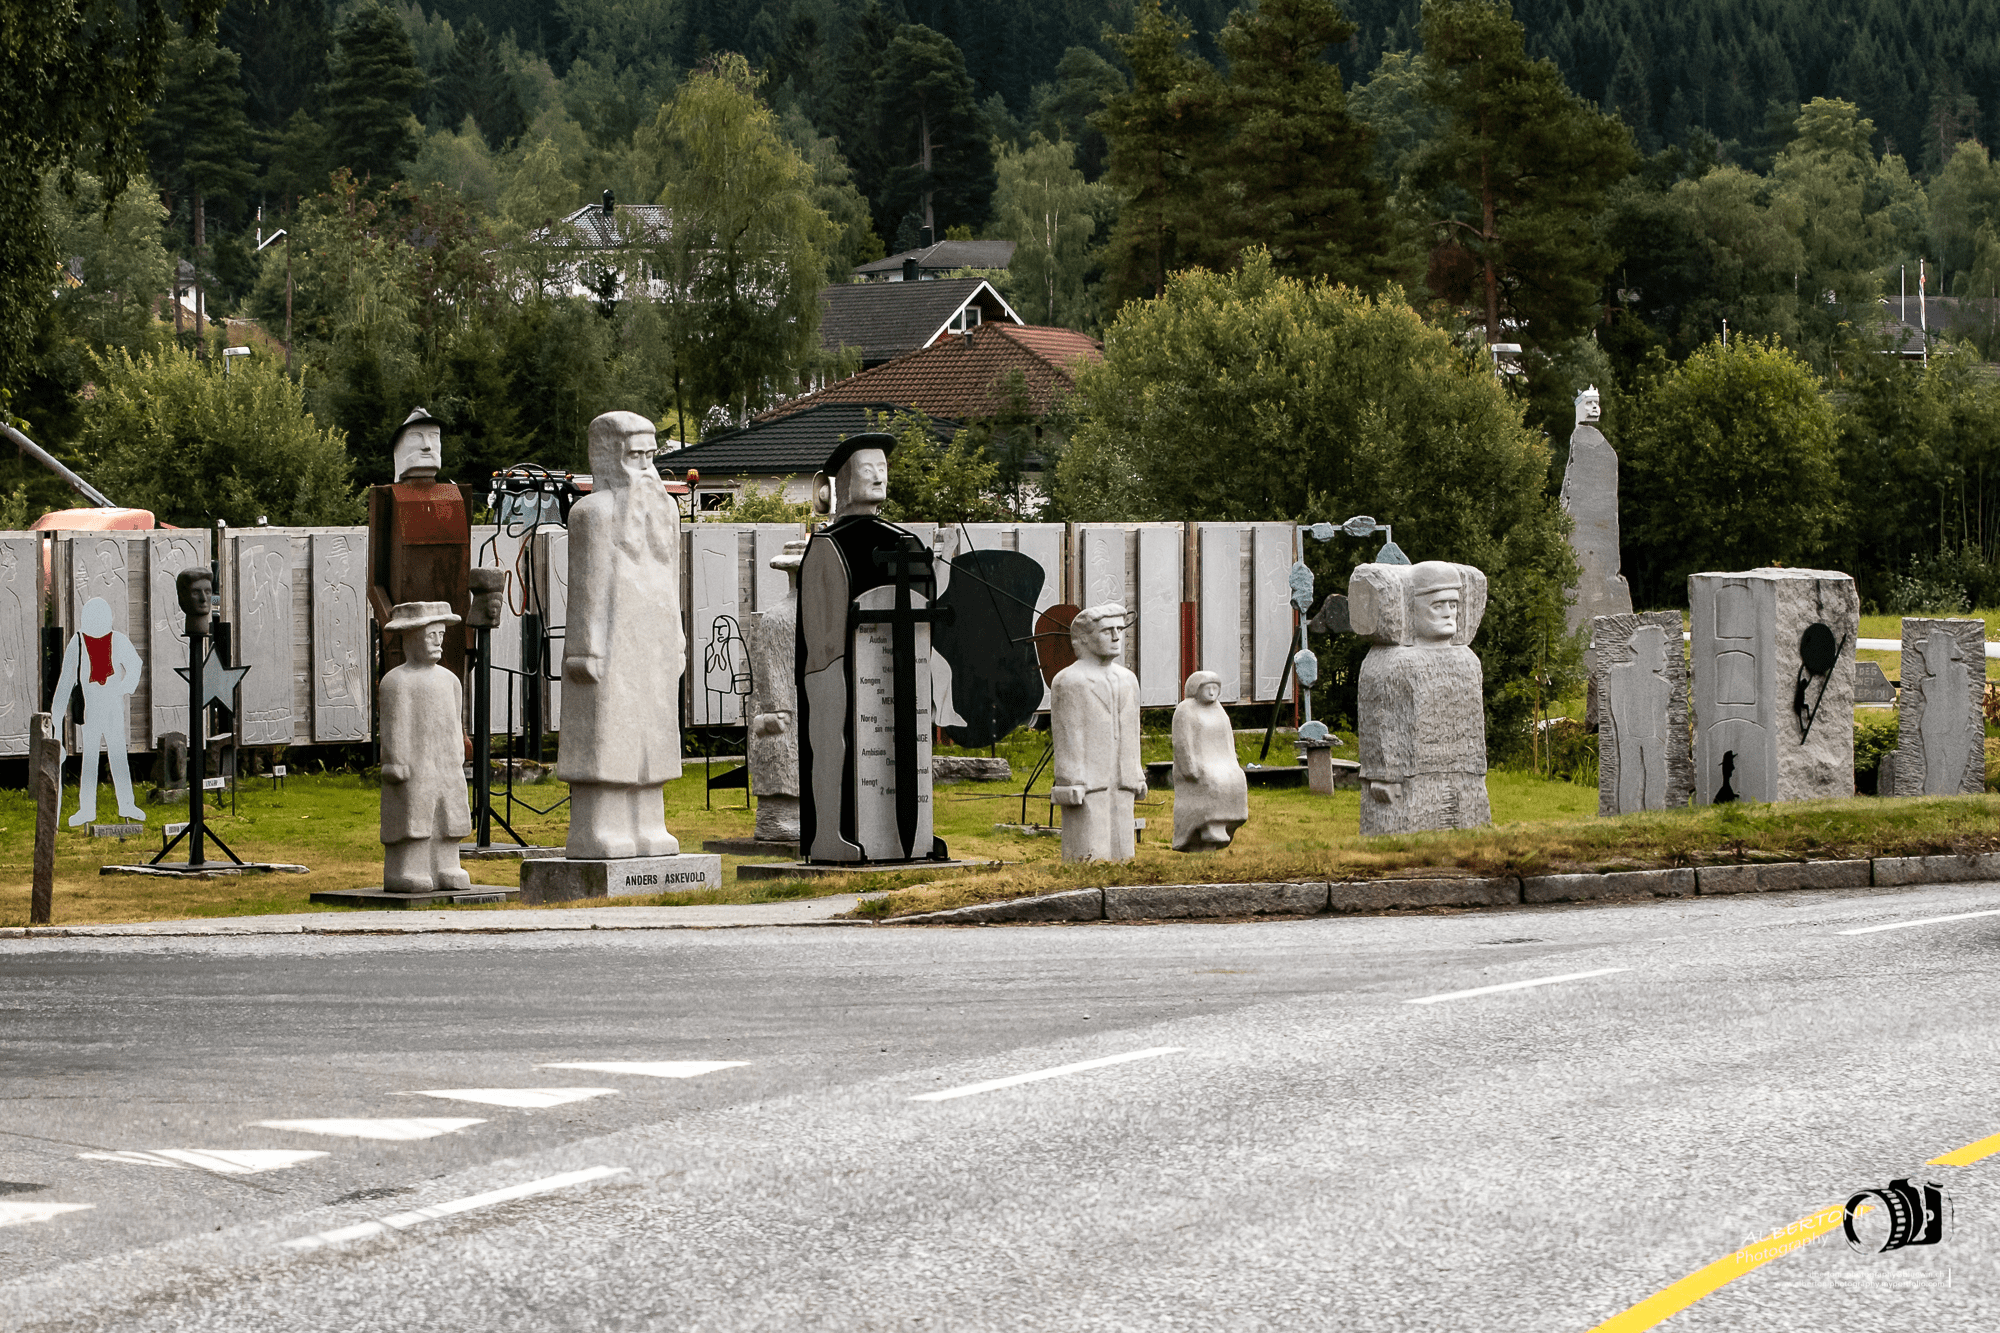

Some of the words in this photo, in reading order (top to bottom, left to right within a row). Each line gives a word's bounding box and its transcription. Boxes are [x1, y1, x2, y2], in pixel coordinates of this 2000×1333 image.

[859, 677, 881, 687] Kongen
[860, 714, 878, 724] Noreg
[861, 778, 878, 787] Hengt
[625, 874, 658, 886] ANDERS
[664, 871, 706, 884] ASKEVOLD
